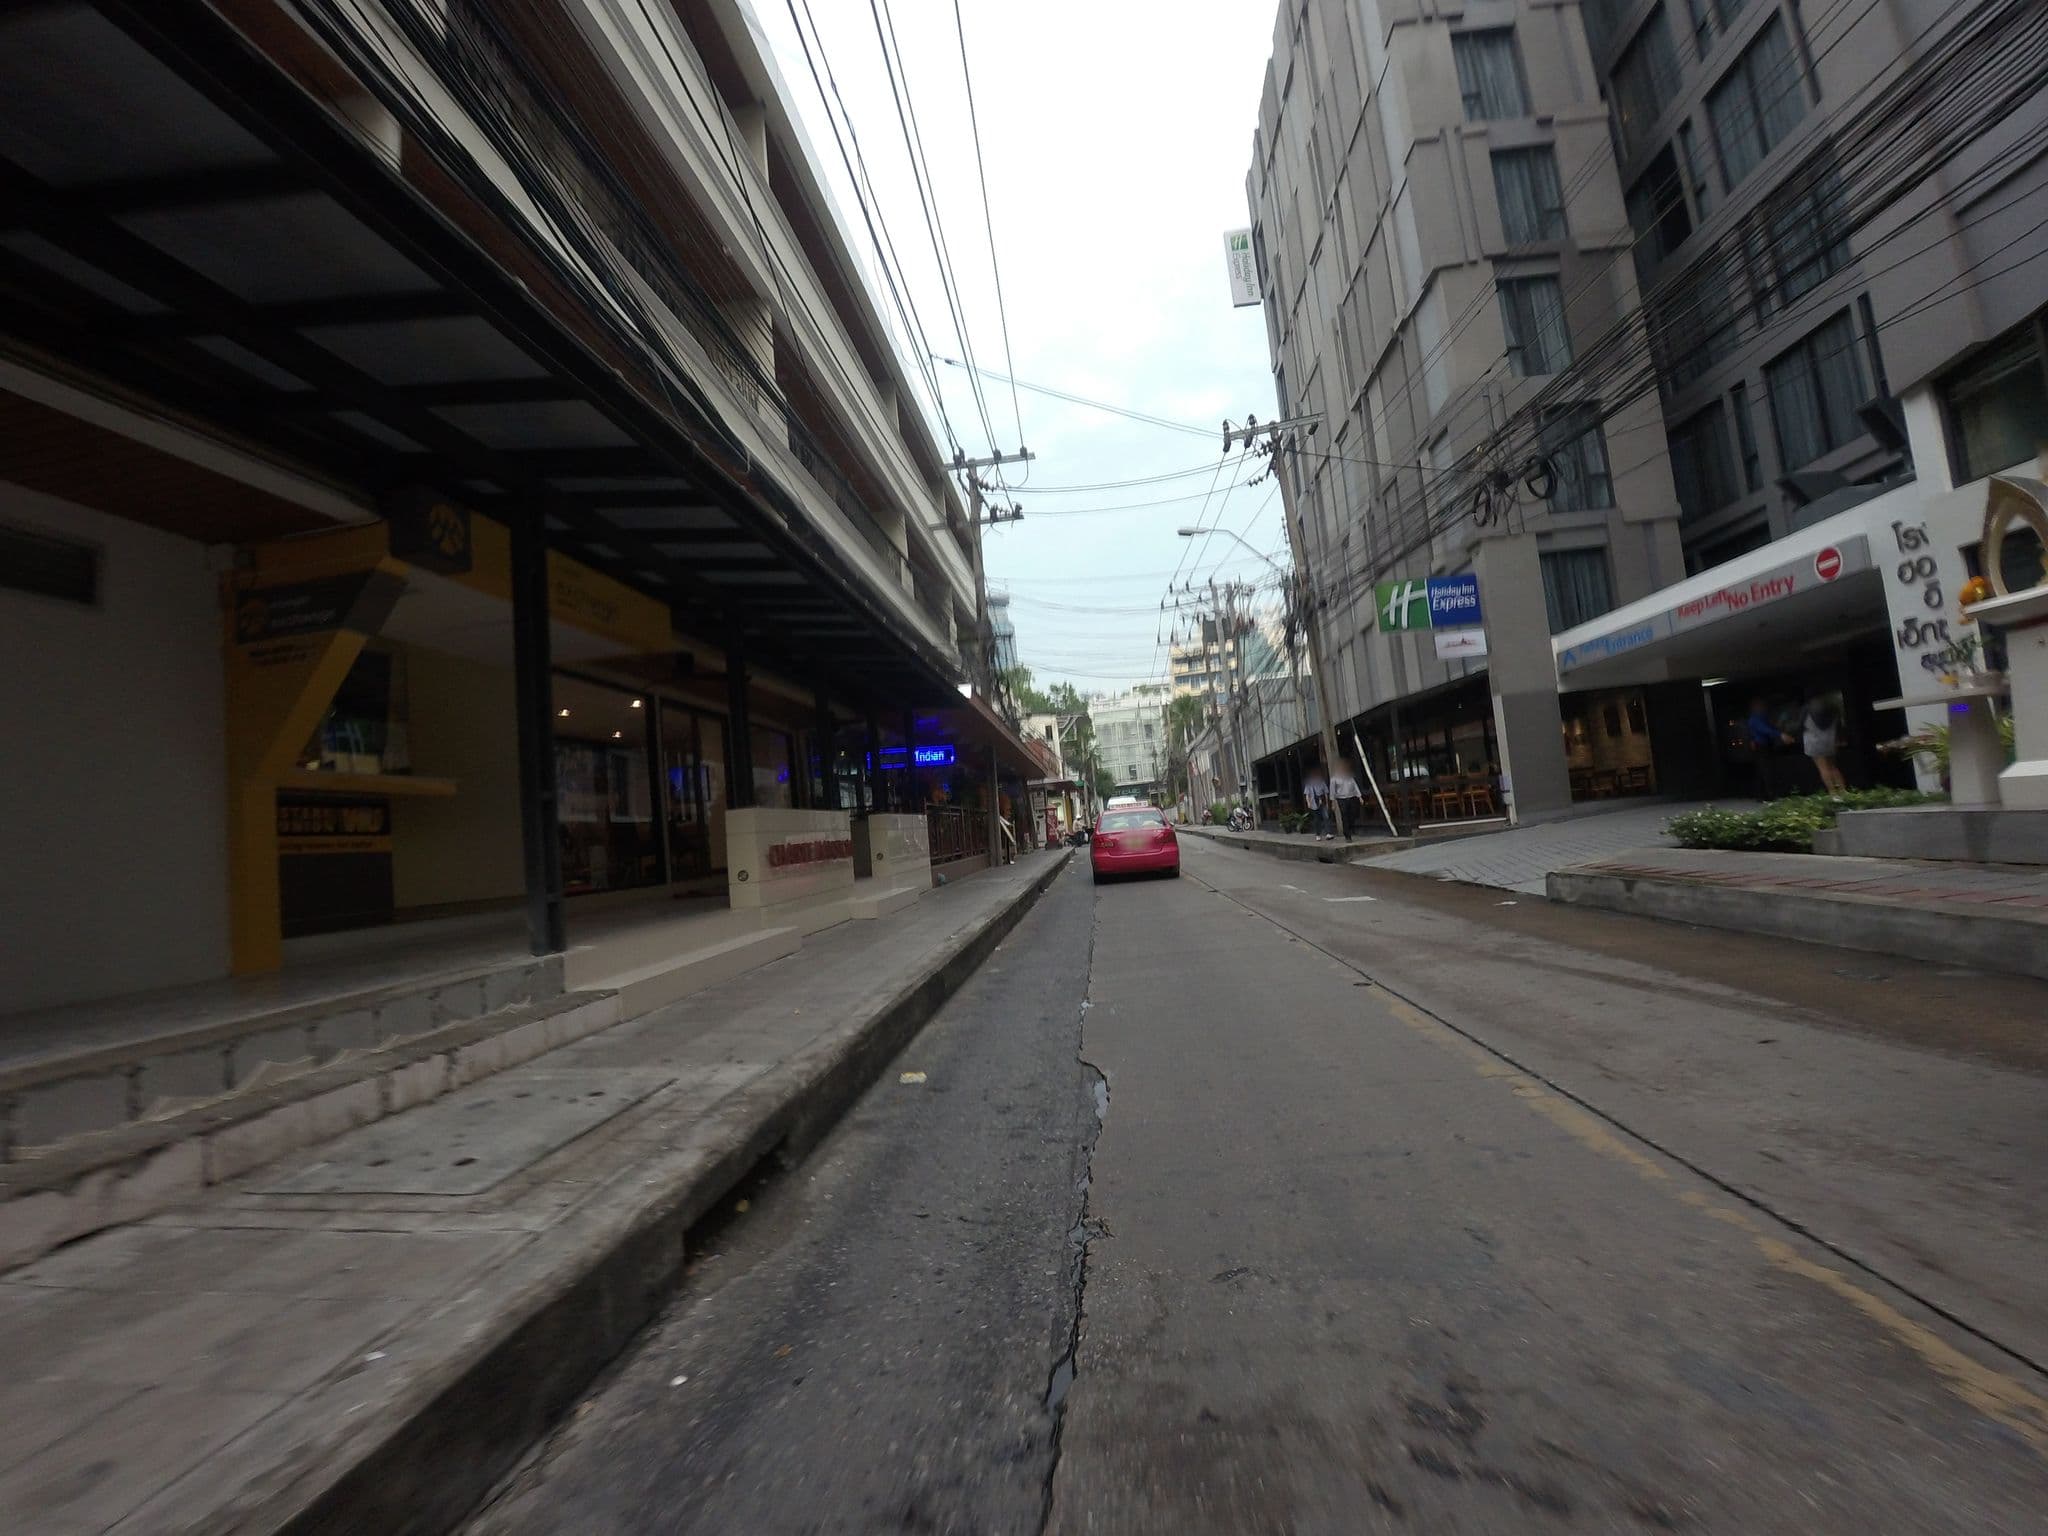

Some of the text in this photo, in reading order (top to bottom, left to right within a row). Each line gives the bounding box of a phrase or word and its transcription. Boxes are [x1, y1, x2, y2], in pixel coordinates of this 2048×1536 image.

[1431, 583, 1475, 598] Holiday Inn
[1727, 589, 1748, 611] No
[1750, 575, 1795, 602] Entry
[1432, 595, 1476, 613] Express
[914, 750, 946, 763] Indian
